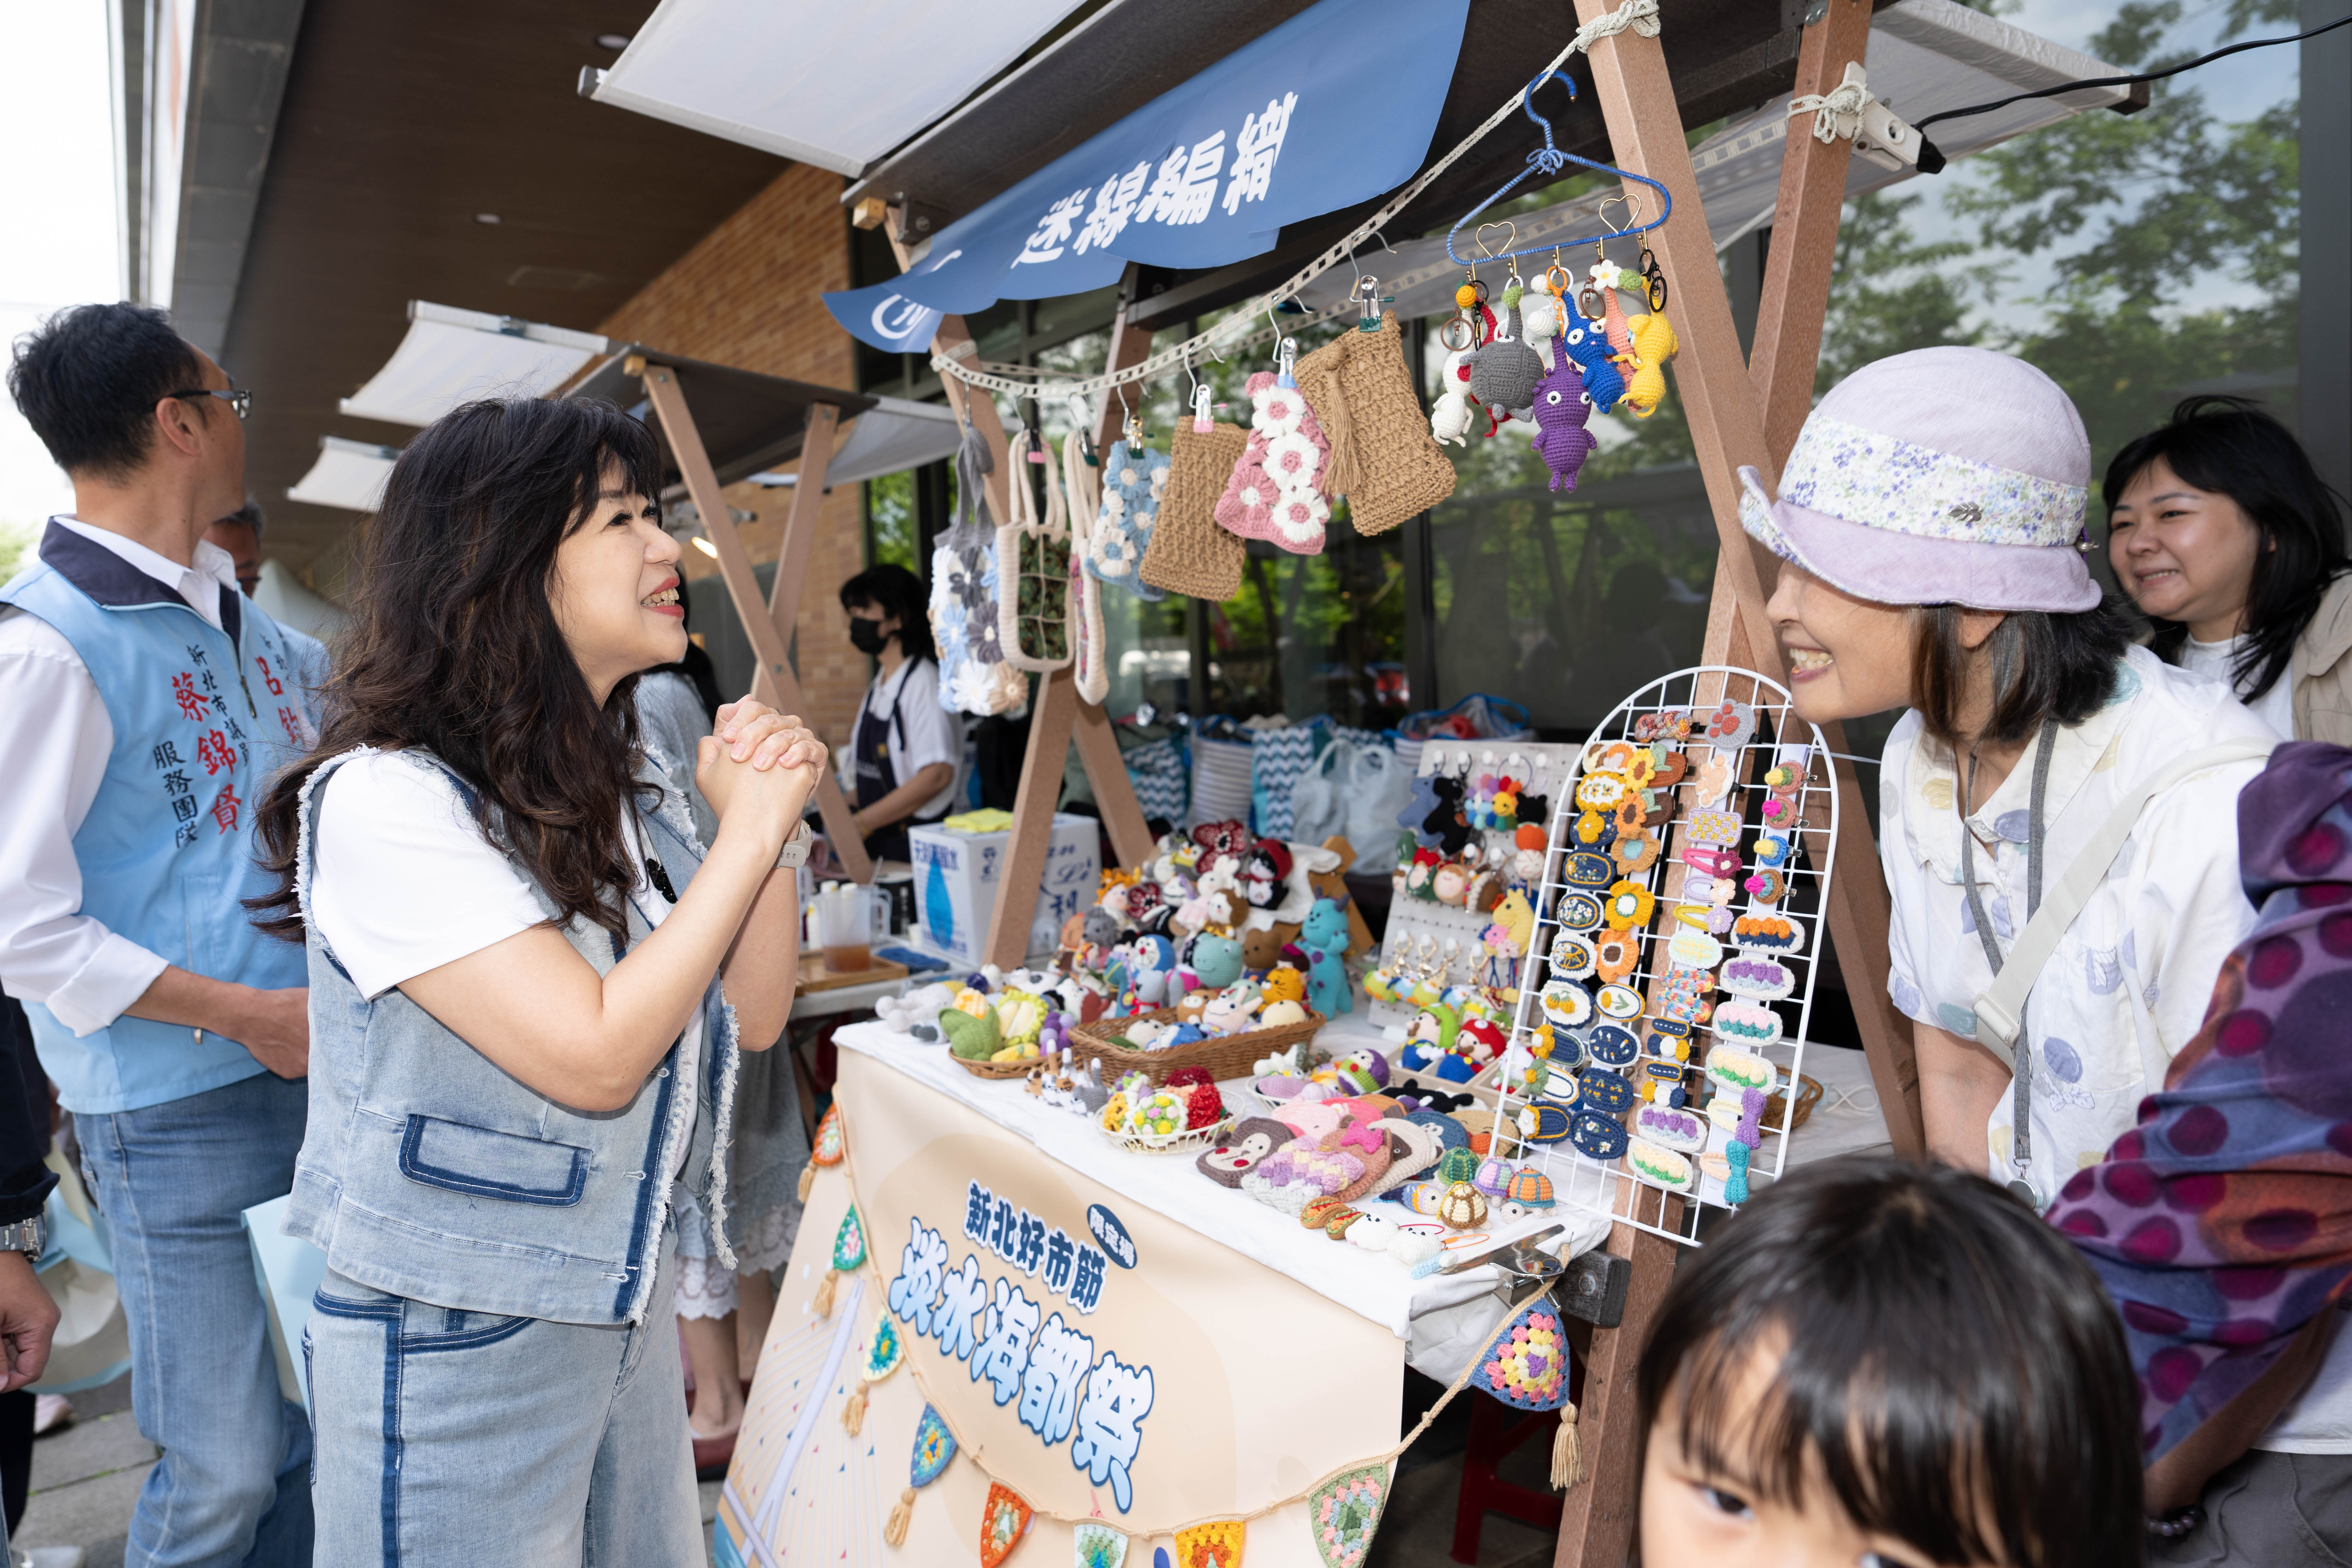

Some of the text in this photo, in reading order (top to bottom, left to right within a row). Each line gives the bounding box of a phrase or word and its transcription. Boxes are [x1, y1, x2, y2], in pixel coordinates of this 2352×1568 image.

[153, 741, 198, 848] 服務團隊
[965, 1182, 1106, 1311] 新北好市節
[1090, 1206, 1134, 1267] 限定場
[889, 1216, 1154, 1514] 淡水海都祭
